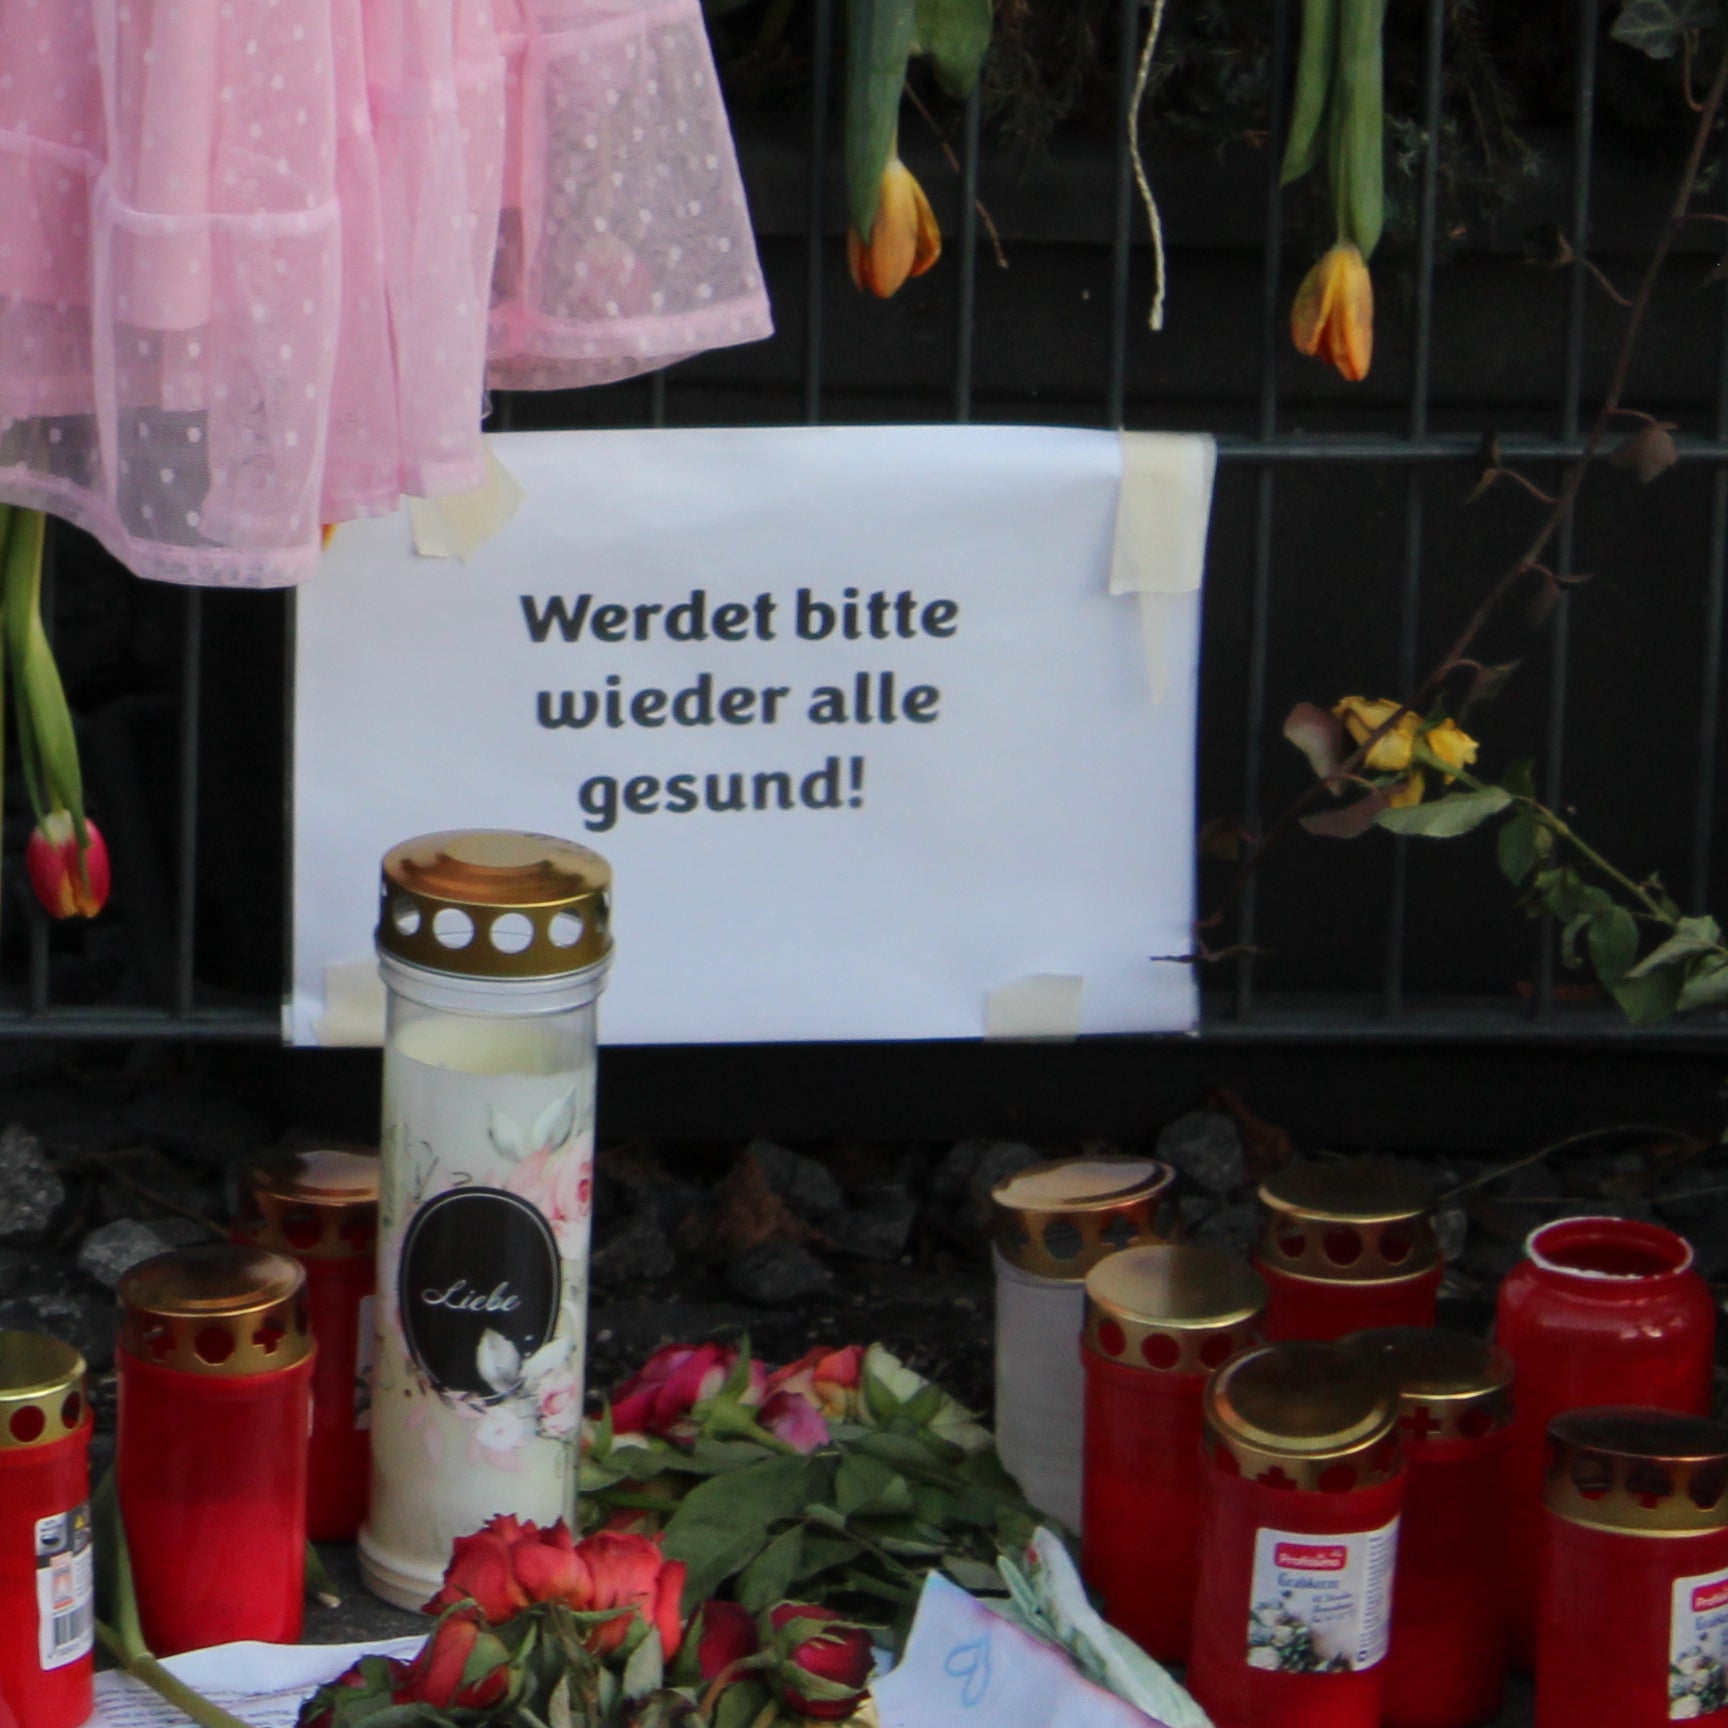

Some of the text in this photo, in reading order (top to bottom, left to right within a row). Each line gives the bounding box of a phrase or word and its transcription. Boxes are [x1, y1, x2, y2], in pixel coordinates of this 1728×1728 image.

[520, 587, 959, 642] Werdet bitte
[536, 671, 940, 729] wieder alle
[578, 756, 864, 833] gesund!
[422, 1279, 522, 1312] Liebe
